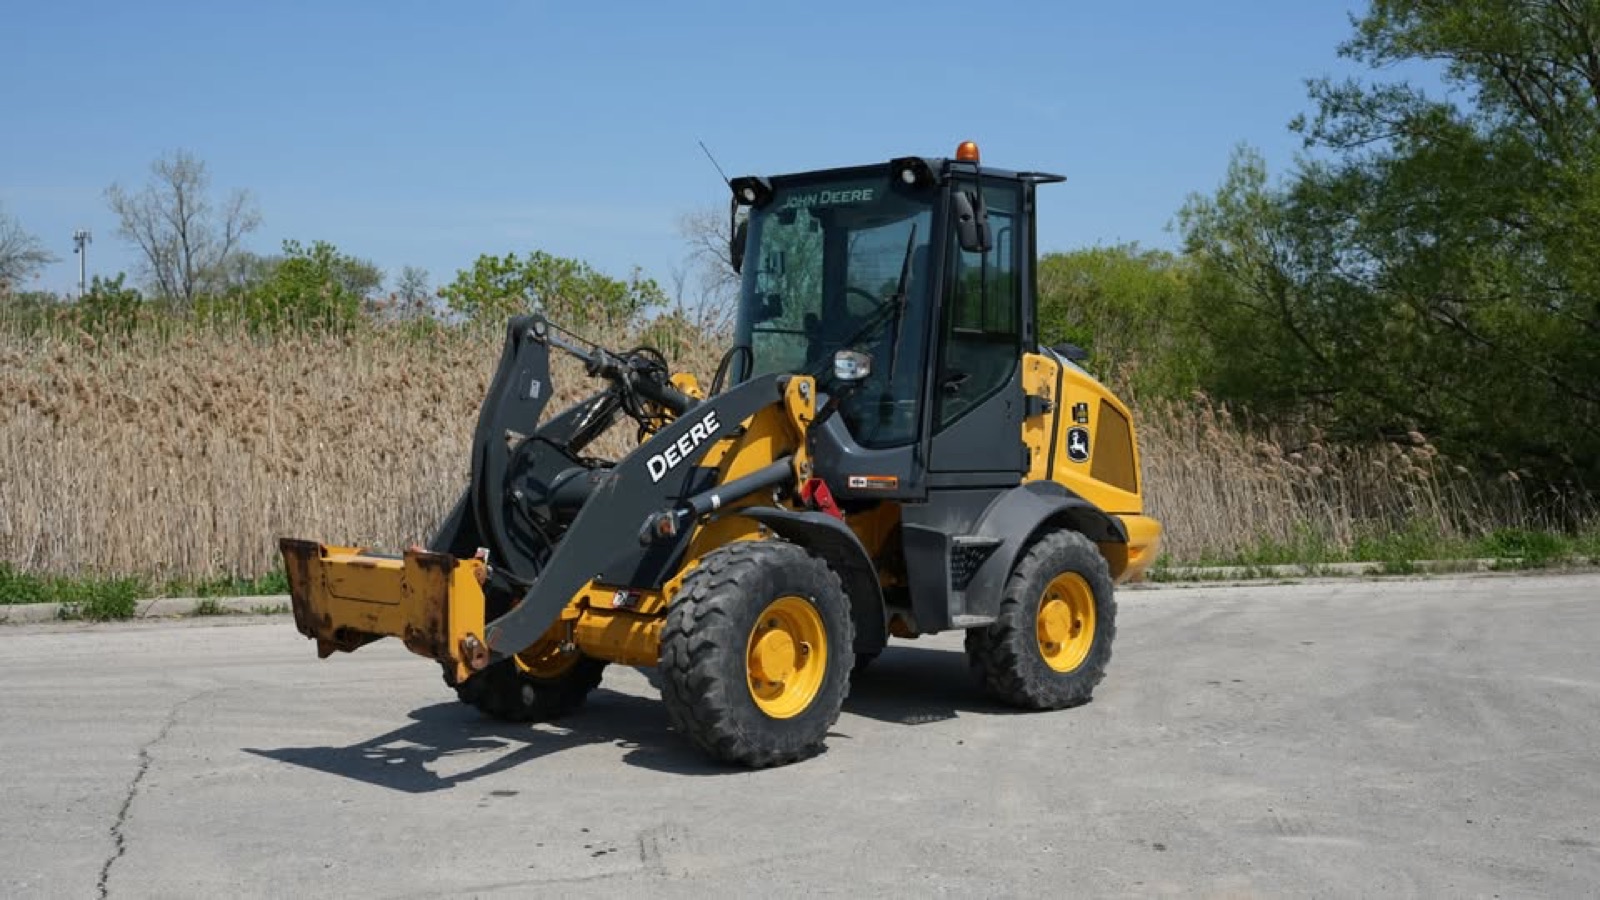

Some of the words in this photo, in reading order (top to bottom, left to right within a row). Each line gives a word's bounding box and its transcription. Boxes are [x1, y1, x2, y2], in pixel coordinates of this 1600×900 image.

[783, 194, 818, 208] JOHN
[820, 189, 874, 204] DEERE
[646, 410, 720, 483] DEERE
